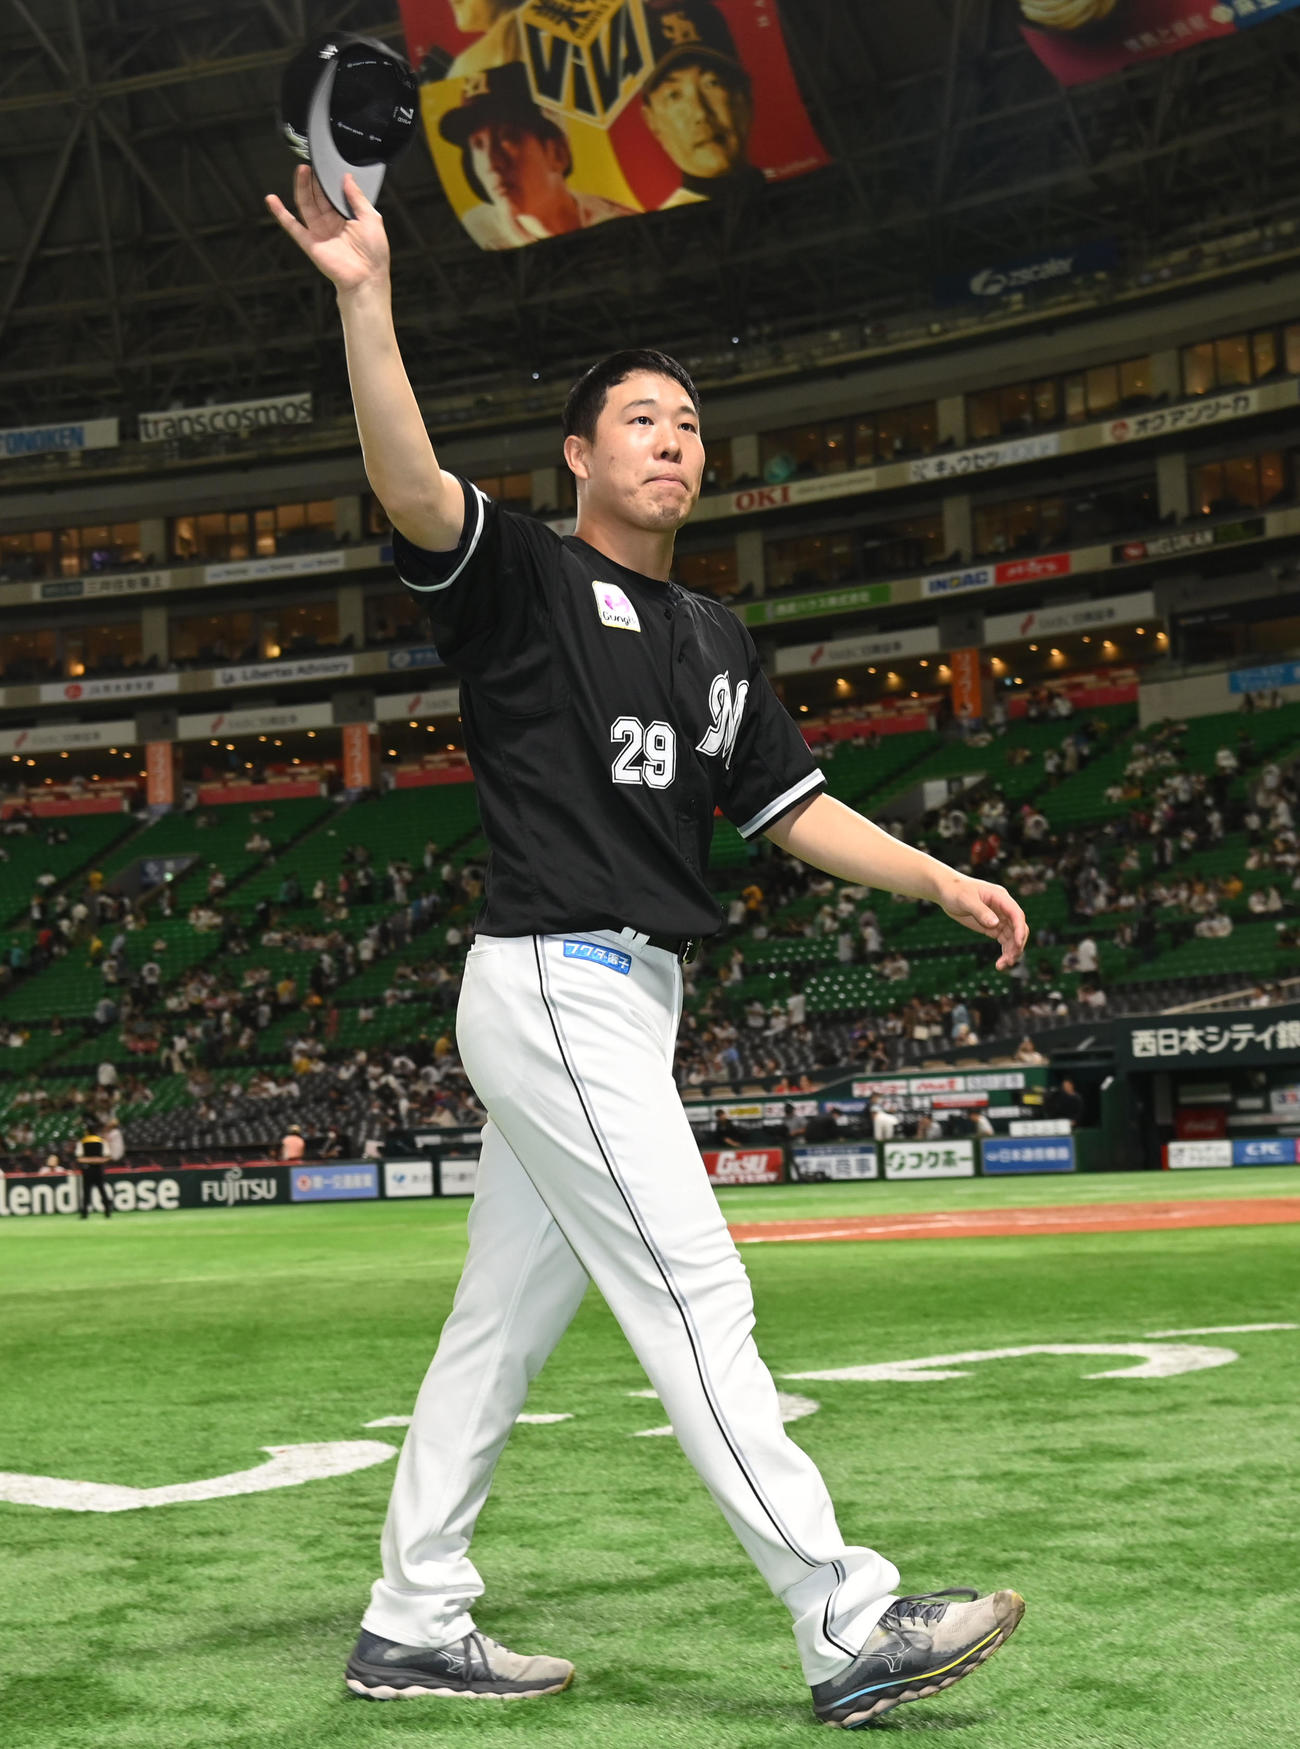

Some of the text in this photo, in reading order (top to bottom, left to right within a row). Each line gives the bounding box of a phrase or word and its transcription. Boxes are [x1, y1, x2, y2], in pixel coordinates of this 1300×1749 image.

[141, 399, 311, 439] transcosmos
[736, 485, 789, 511] OKI
[929, 571, 988, 592] INOAC
[610, 716, 676, 789] 29
[565, 943, 630, 969] フクダ電子
[1131, 1020, 1300, 1058] 西日本シティ銀
[201, 1167, 277, 1206] FUJITSU
